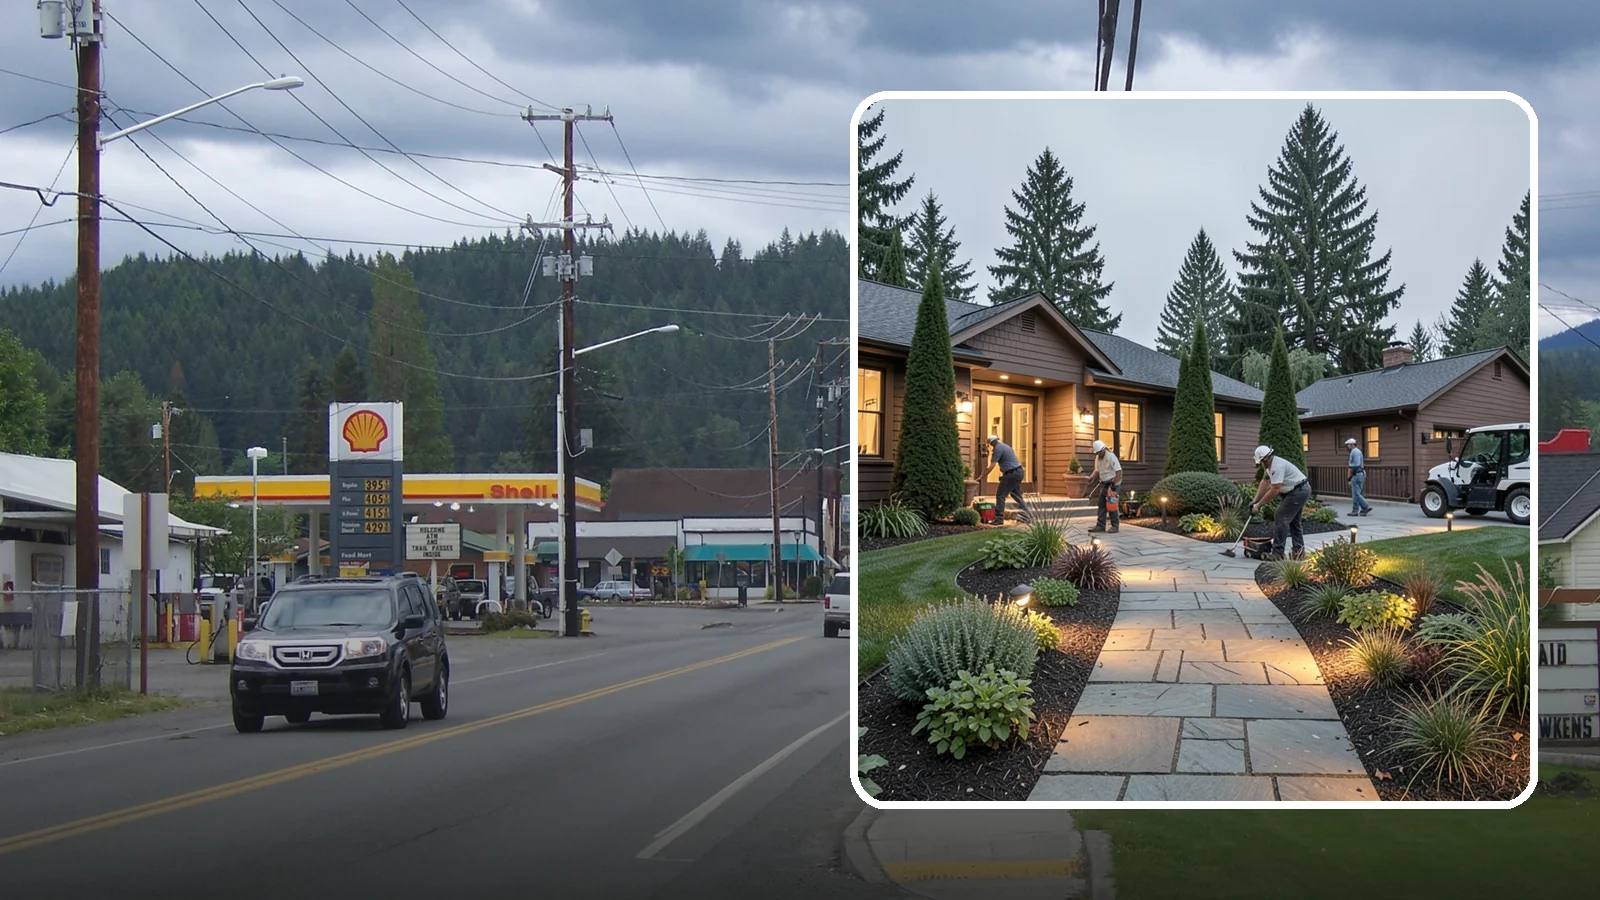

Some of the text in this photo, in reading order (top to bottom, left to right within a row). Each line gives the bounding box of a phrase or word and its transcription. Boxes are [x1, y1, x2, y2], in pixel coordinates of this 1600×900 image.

[366, 480, 383, 490] 395
[490, 484, 547, 499] Shell
[366, 494, 383, 504] 405
[366, 508, 383, 518] 415
[366, 522, 383, 532] 429
[1538, 643, 1567, 665] AID
